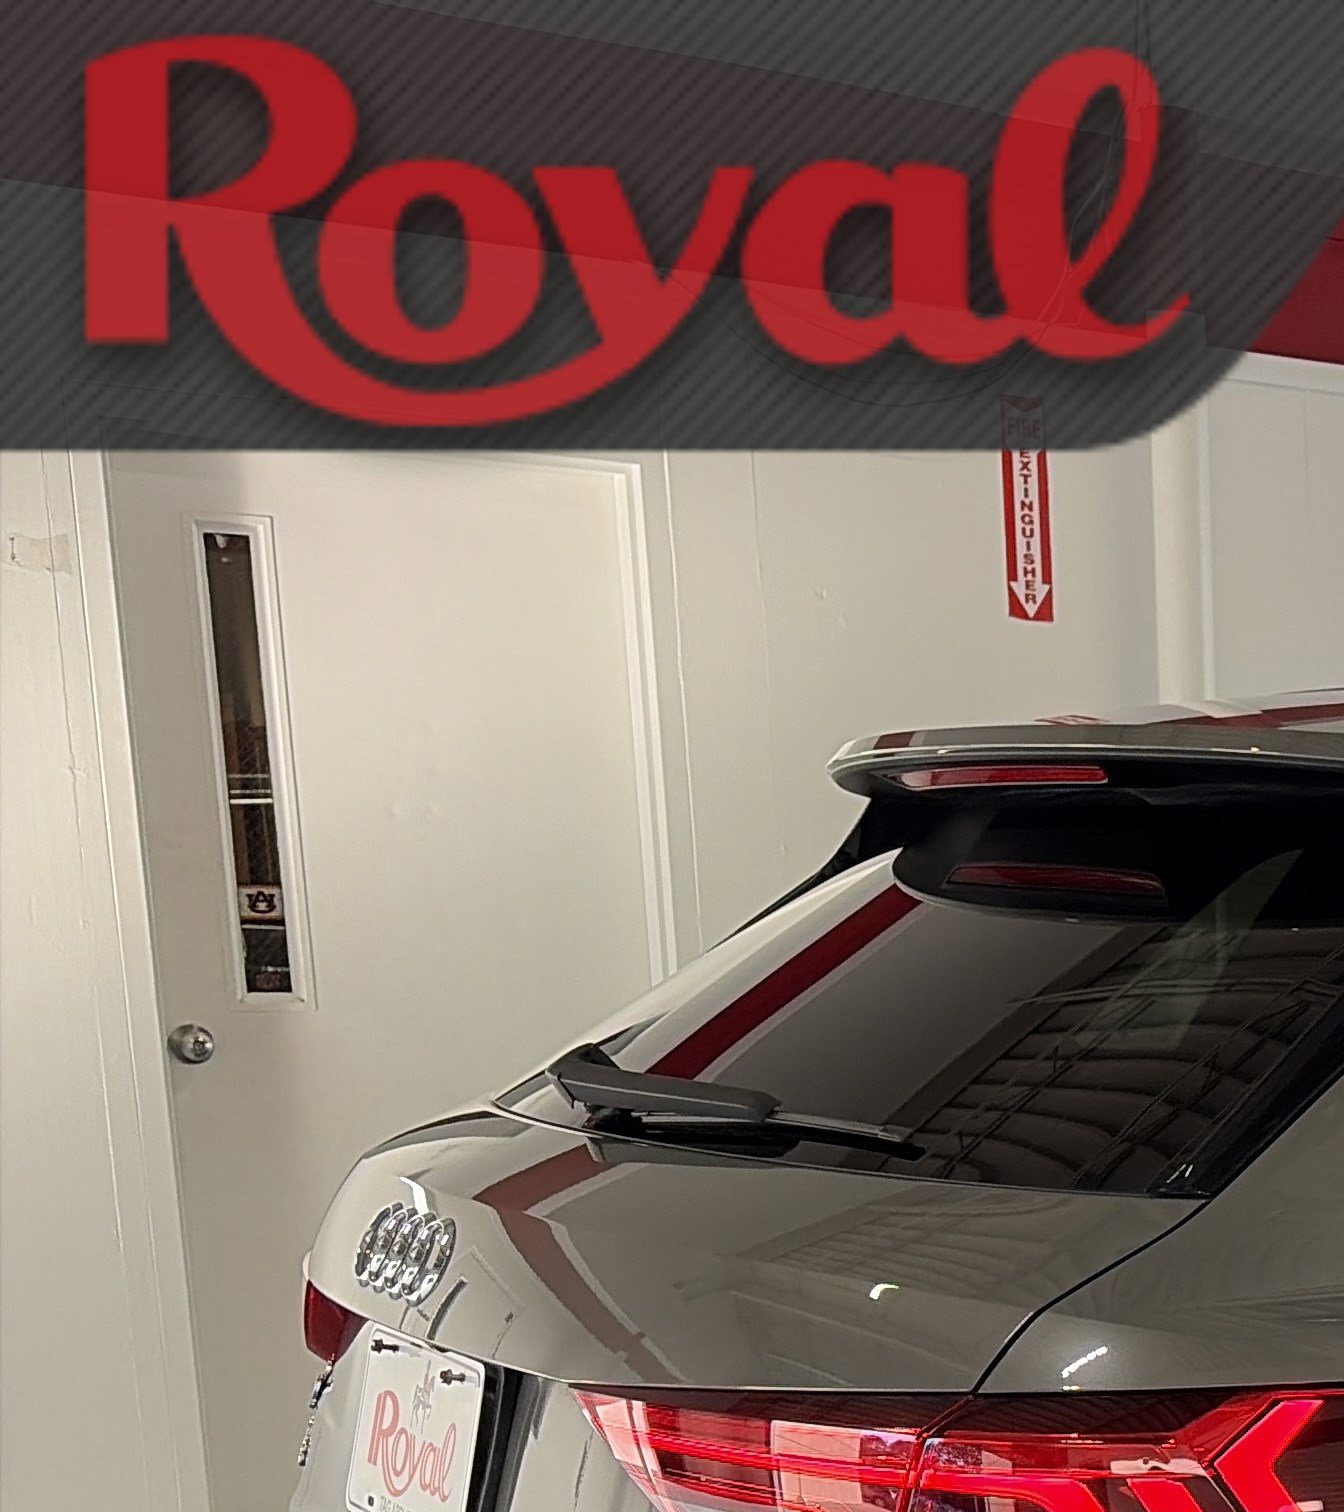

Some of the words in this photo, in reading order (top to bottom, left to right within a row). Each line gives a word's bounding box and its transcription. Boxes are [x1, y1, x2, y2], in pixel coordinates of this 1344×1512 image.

[1008, 417, 1041, 440] FIRE
[1018, 447, 1037, 605] EXTINGUISHER
[367, 1389, 457, 1503] Royal
